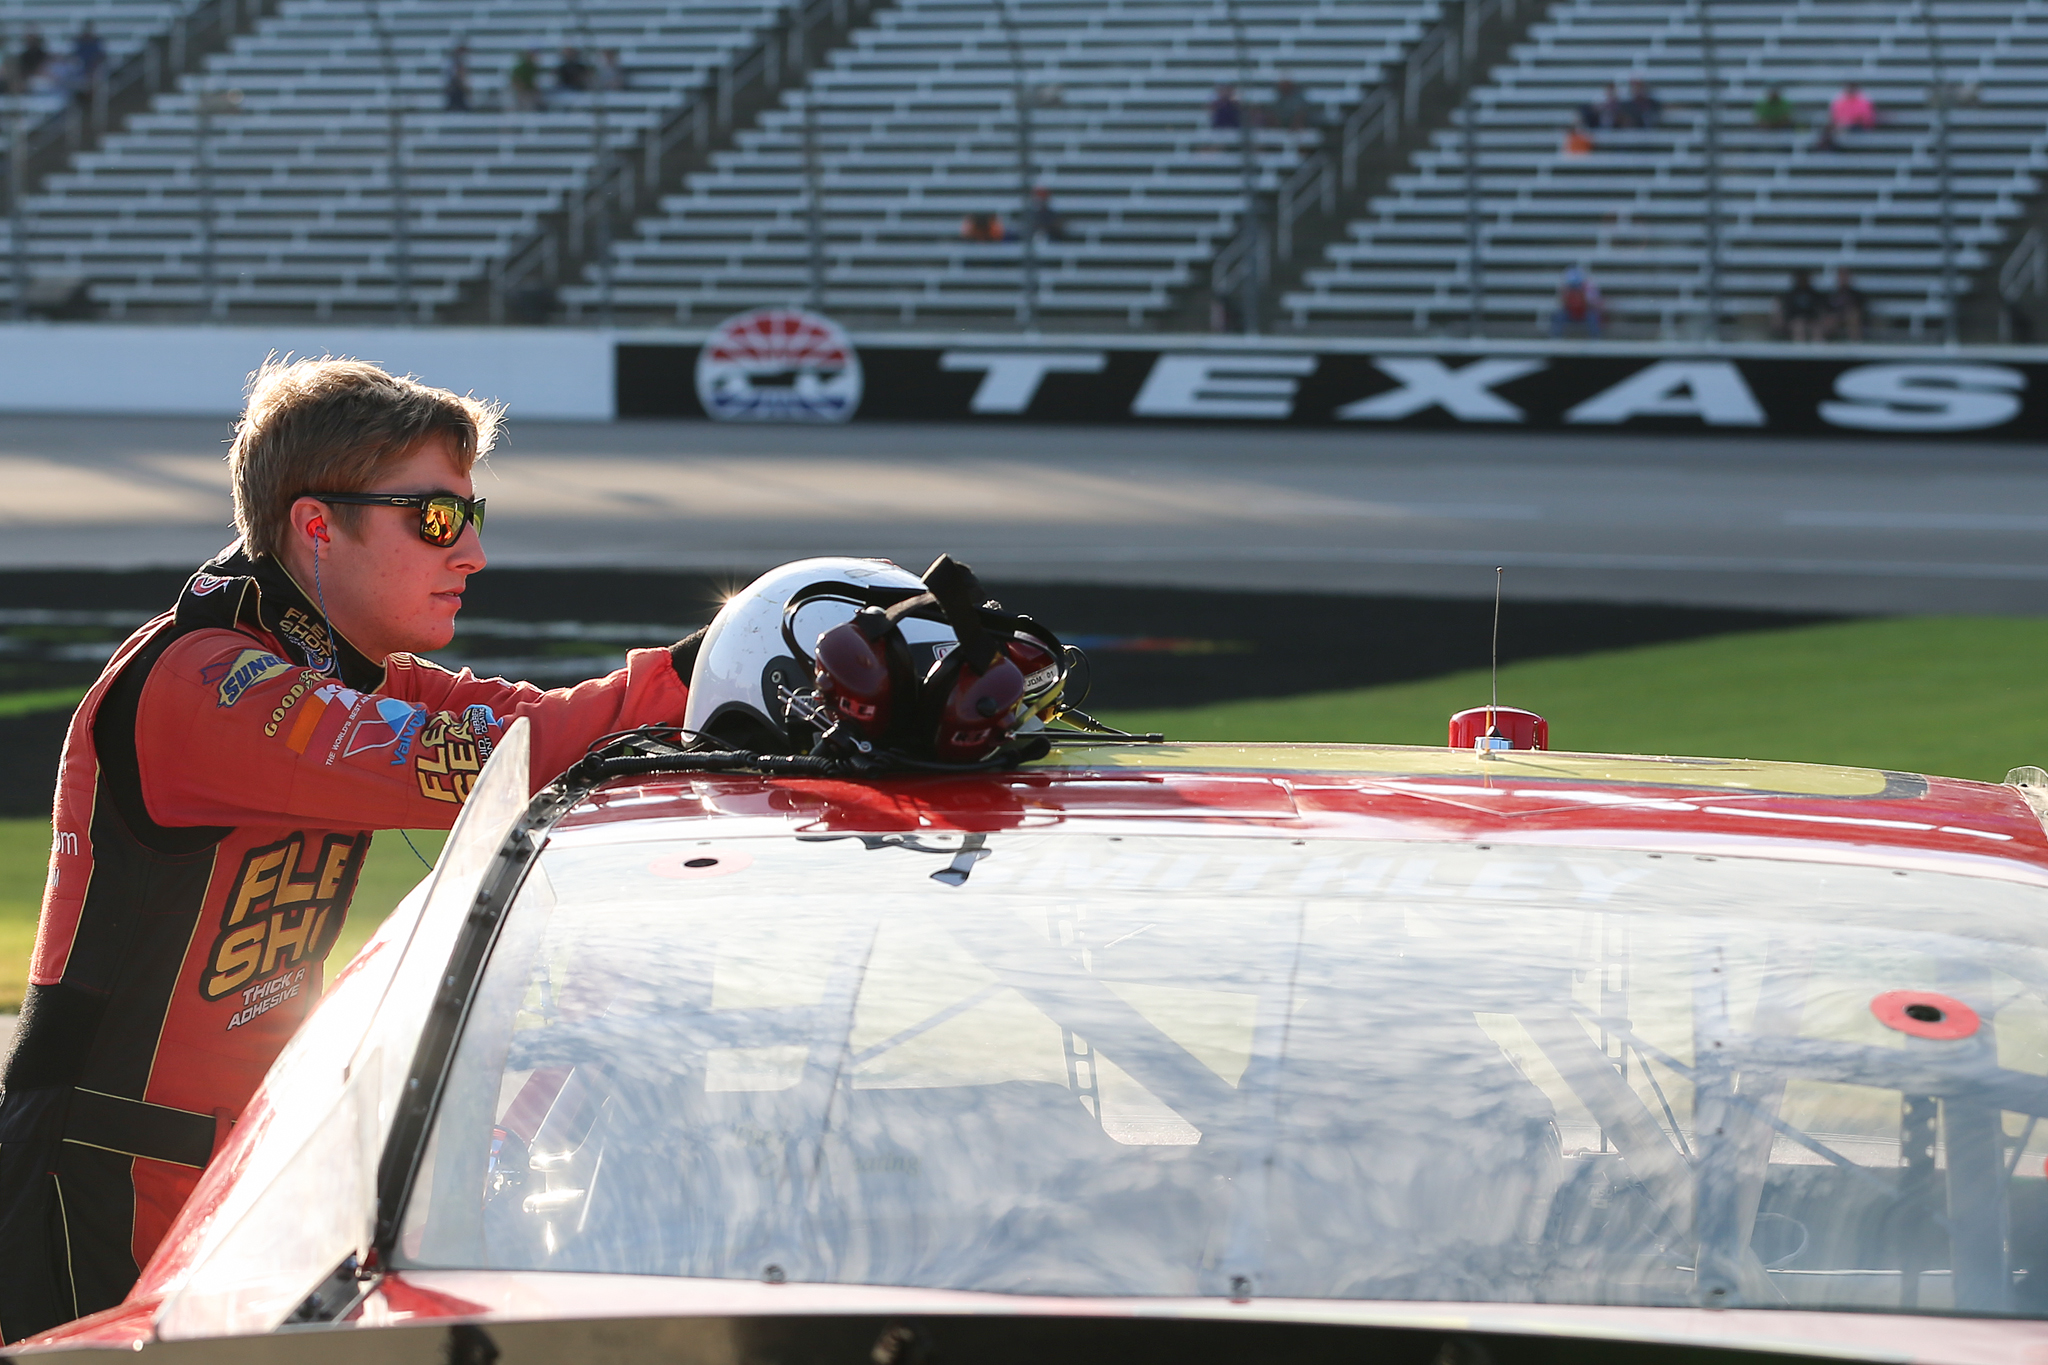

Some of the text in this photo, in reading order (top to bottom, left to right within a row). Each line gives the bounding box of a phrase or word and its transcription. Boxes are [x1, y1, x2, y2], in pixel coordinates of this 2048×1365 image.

[938, 352, 2026, 430] TEXAS
[279, 620, 330, 657] SHOT
[284, 607, 339, 655] FLEX
[222, 655, 290, 702] SUNO
[325, 750, 336, 766] THE
[349, 703, 362, 720] BEST
[391, 704, 428, 766] Valvo
[227, 841, 352, 926] FLE
[208, 904, 332, 997] SH
[226, 983, 300, 1031] ADHESIVE
[242, 973, 292, 1006] THICK
